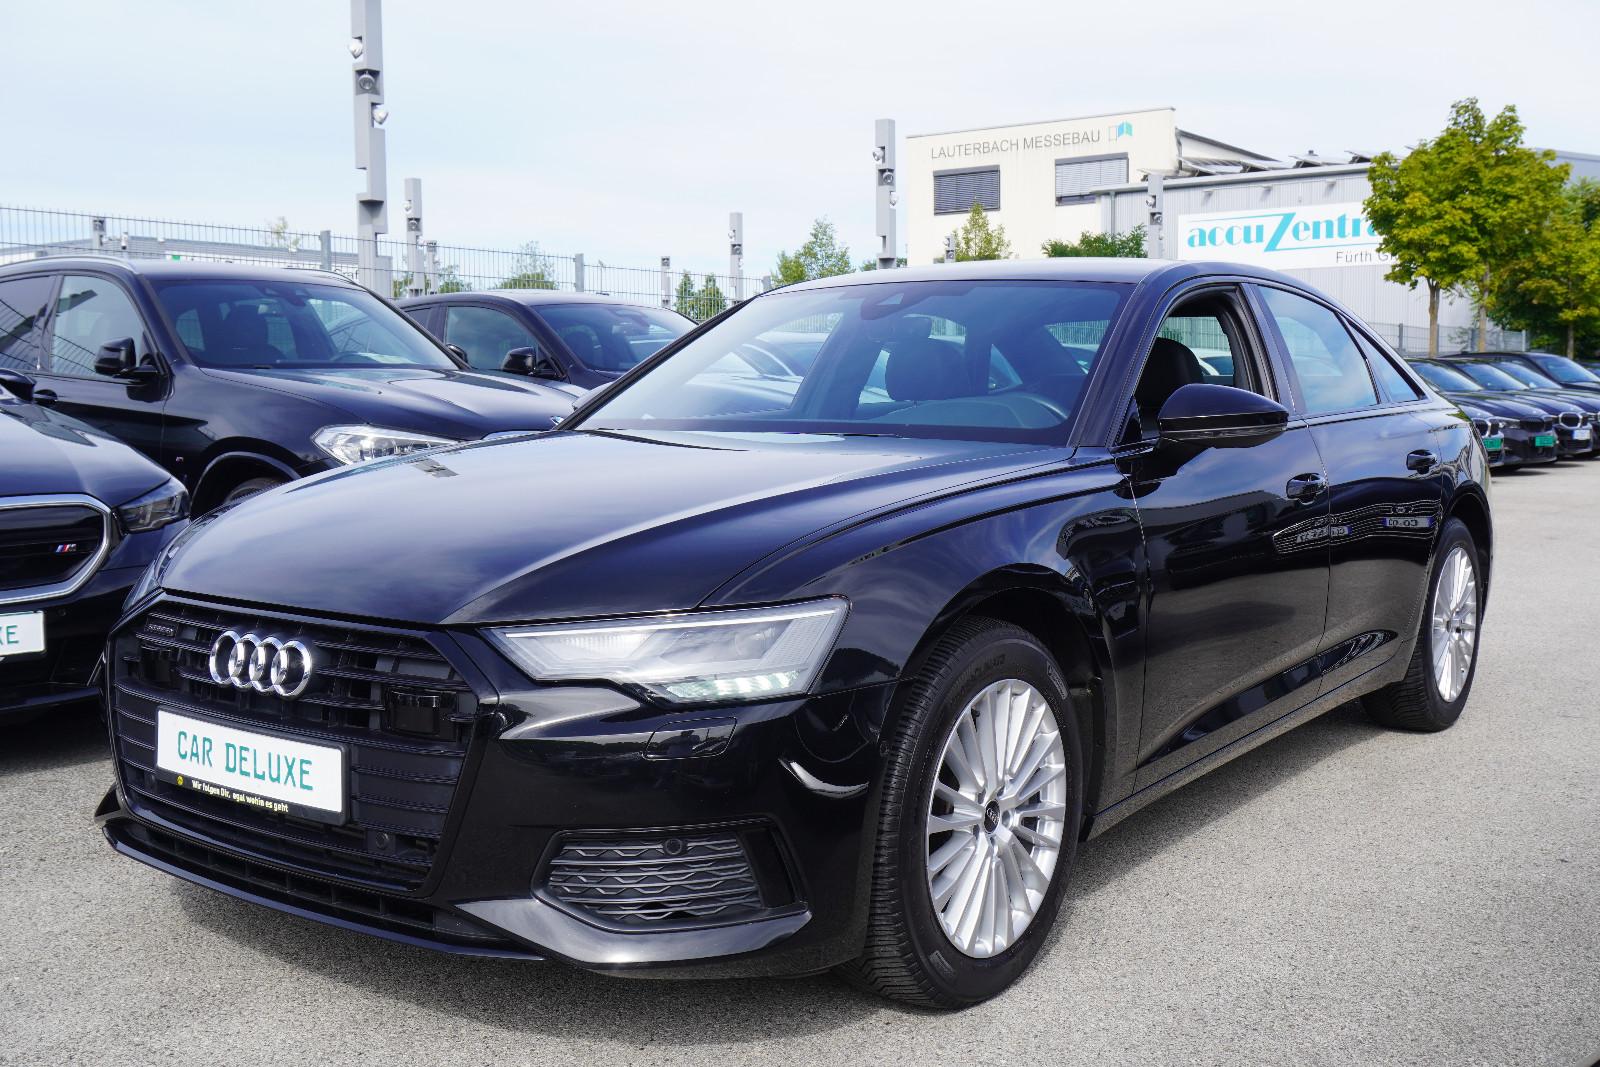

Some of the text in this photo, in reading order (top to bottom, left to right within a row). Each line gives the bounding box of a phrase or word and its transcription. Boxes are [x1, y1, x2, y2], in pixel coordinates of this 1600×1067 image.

[931, 130, 1101, 159] LAUTERBACH MESSEBAU
[1336, 250, 1372, 263] Fürth
[0, 625, 19, 645] E
[177, 730, 313, 791] CAR DELUXE
[192, 780, 201, 790] Wir
[203, 783, 220, 796] folgen
[233, 792, 246, 802] egal
[246, 795, 265, 807] wohin
[265, 801, 273, 809] es
[273, 804, 289, 812] geht
